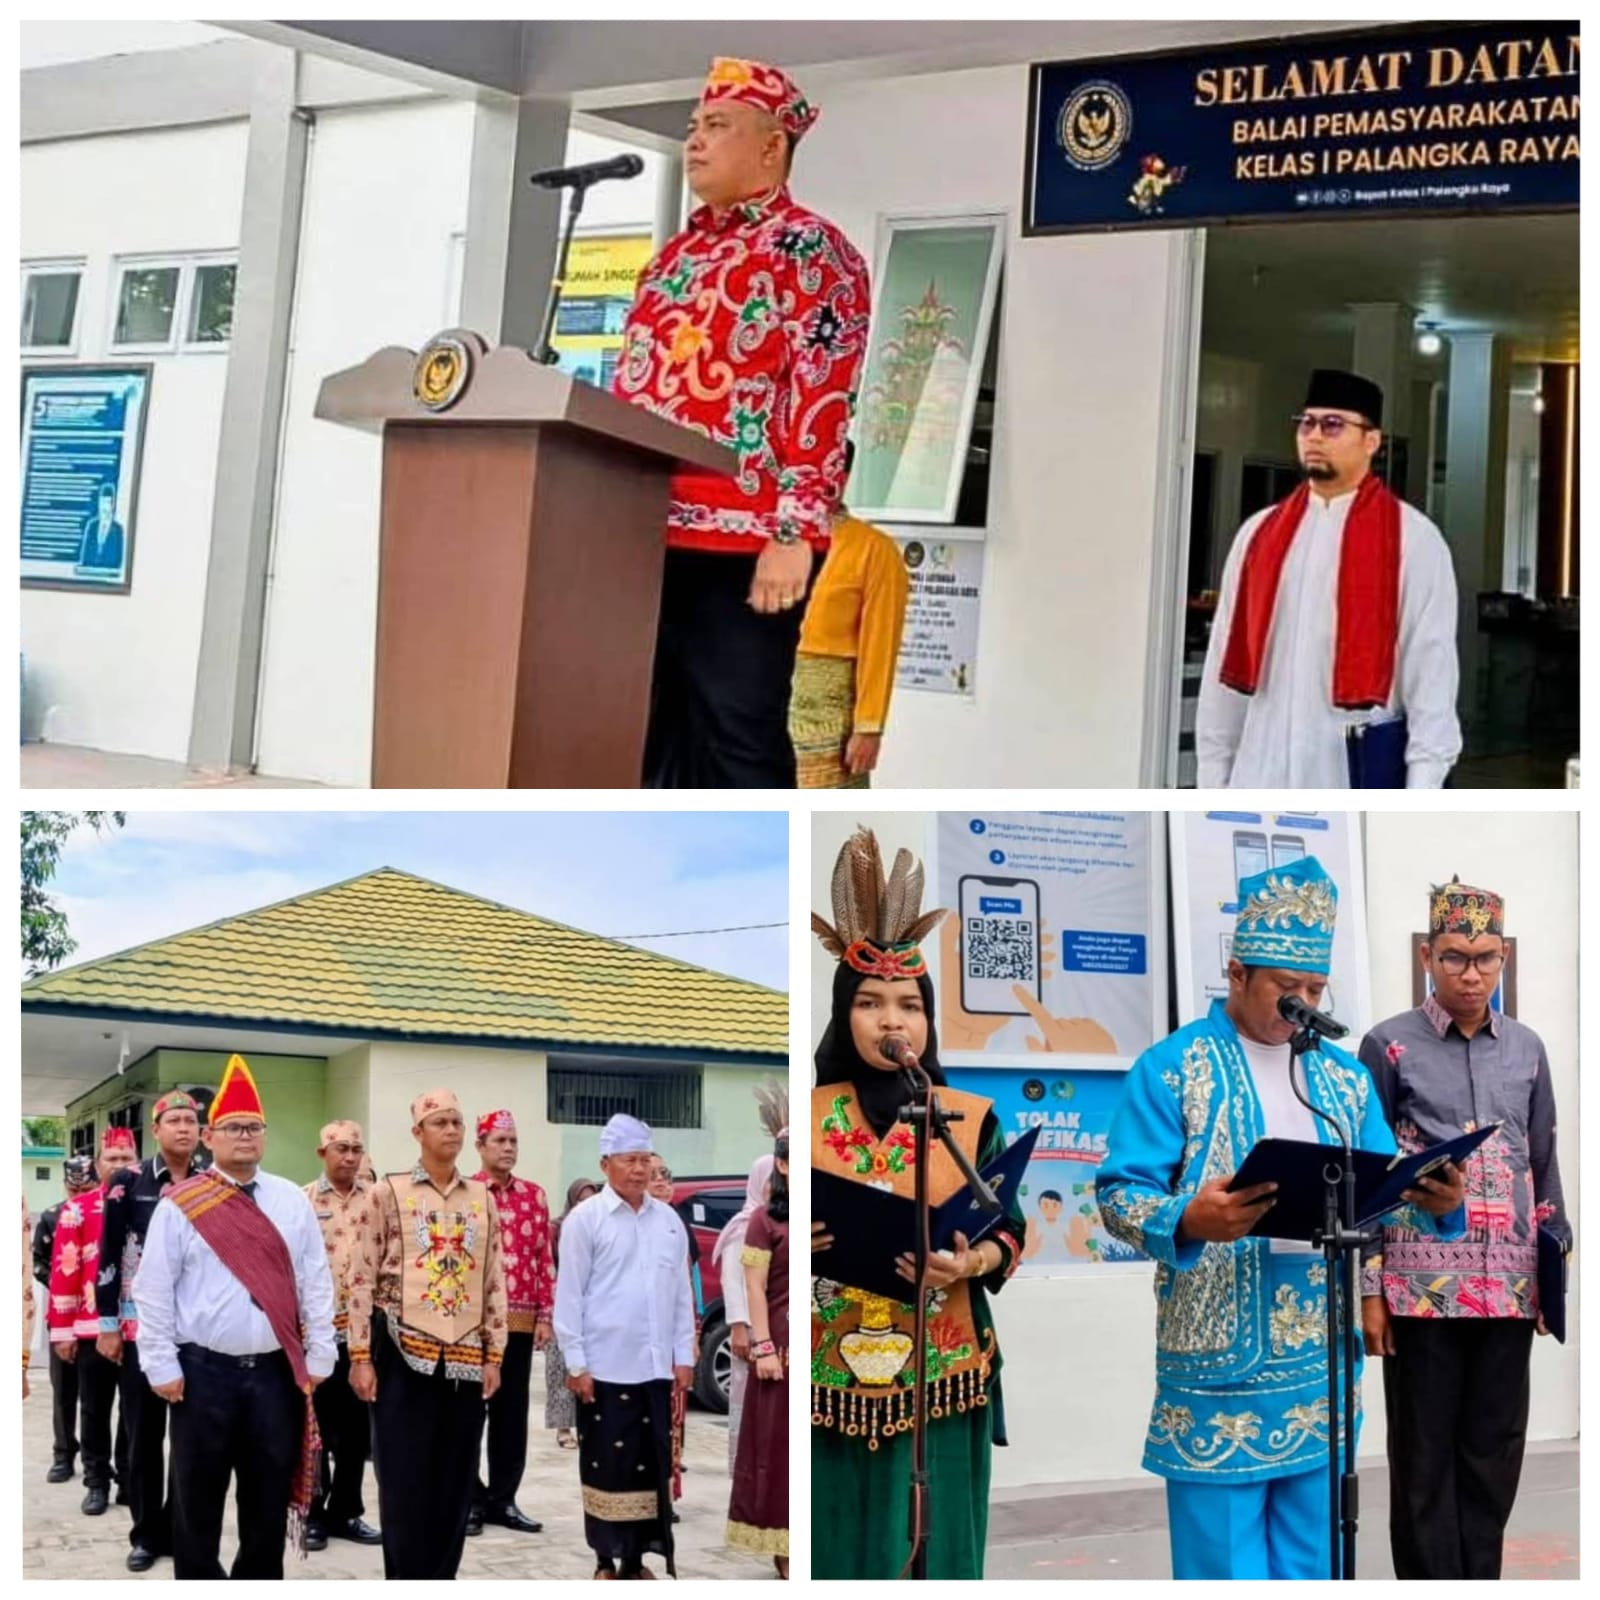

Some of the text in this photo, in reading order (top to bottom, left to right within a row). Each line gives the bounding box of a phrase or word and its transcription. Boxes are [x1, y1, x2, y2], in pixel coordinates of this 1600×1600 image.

[1194, 50, 1412, 107] SELAMAT
[1231, 115, 1307, 144] BALAI
[1235, 133, 1581, 180] KELAS I PALANGKA RAYA
[1426, 184, 1479, 199] Palangka
[1480, 182, 1511, 196] Raya
[603, 268, 636, 283] SINGG
[974, 821, 982, 832] 2
[1015, 1110, 1081, 1129] TOLAK
